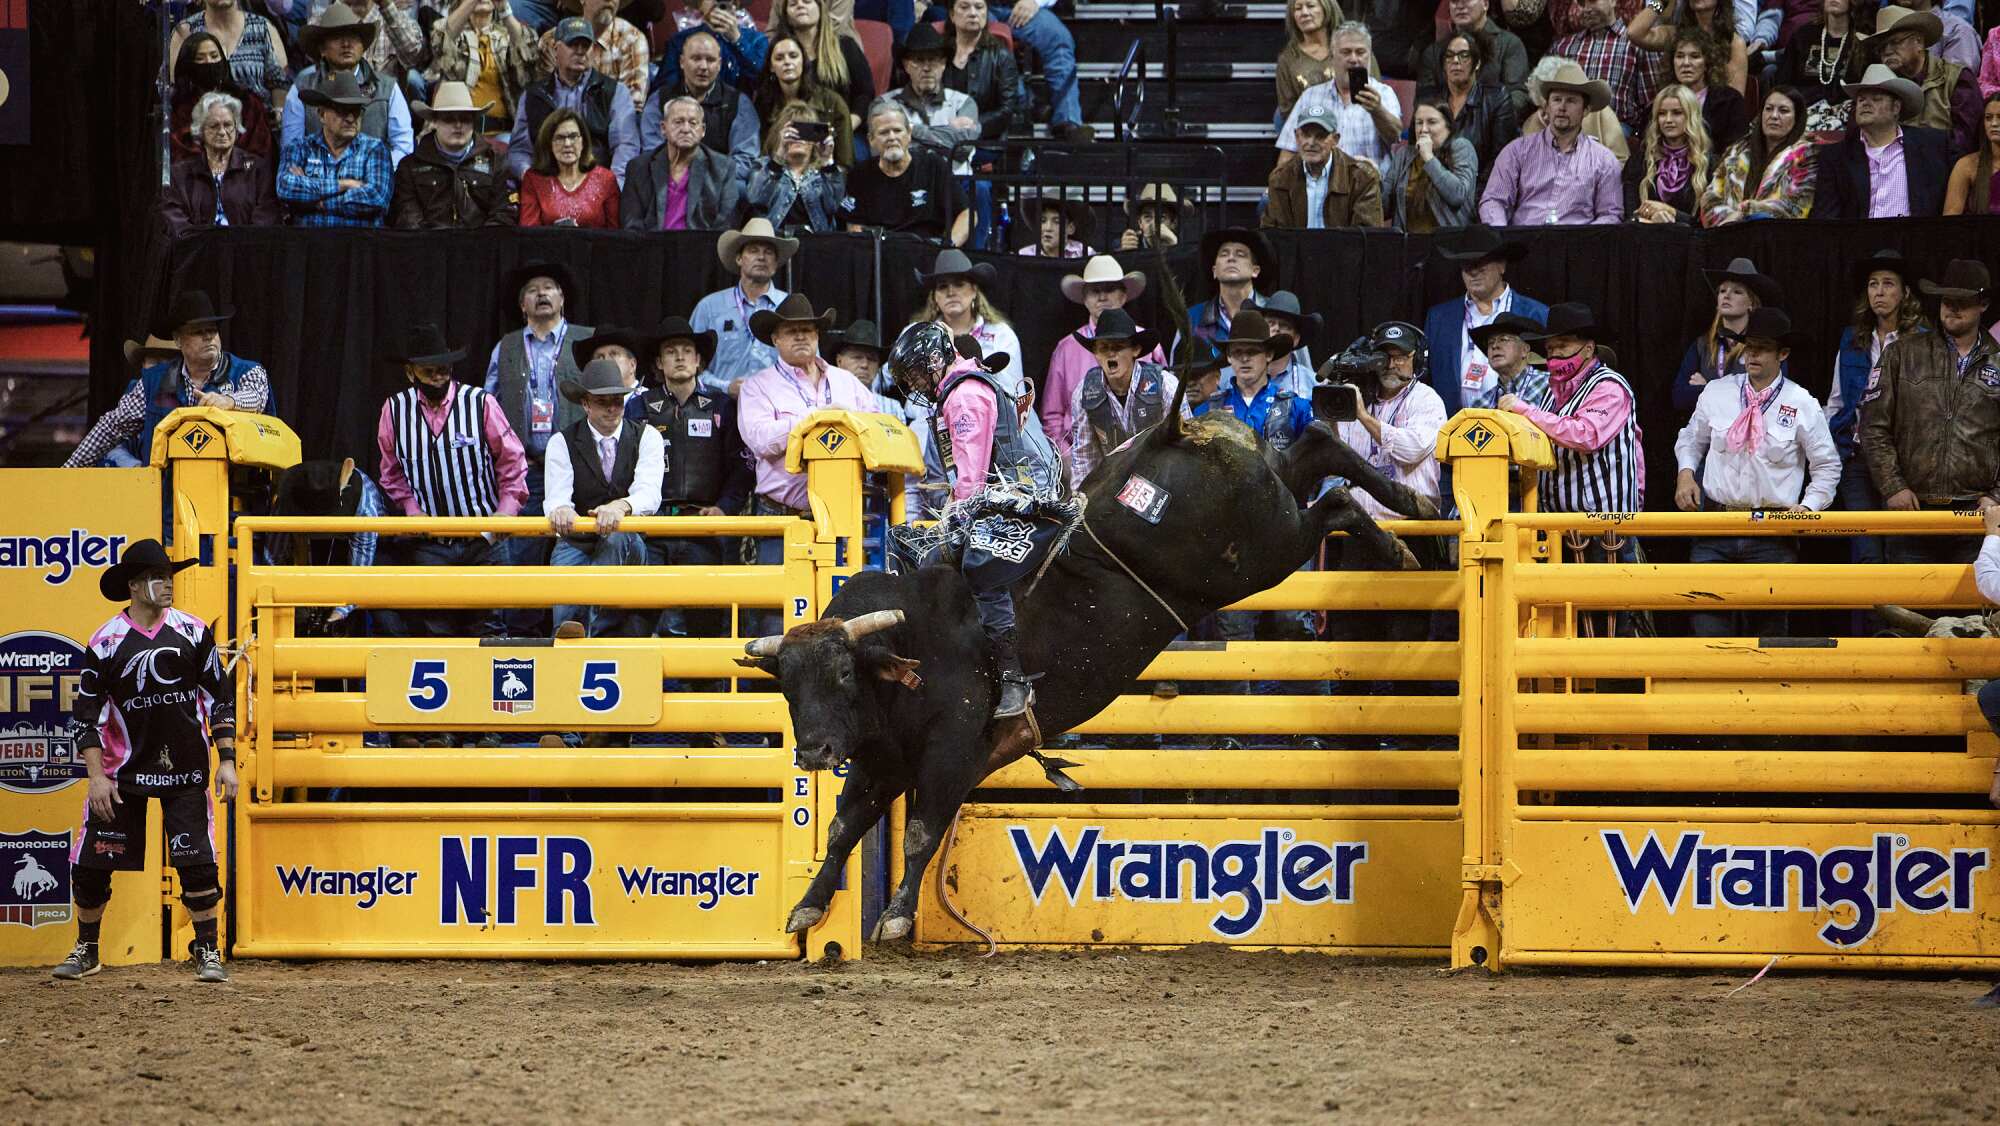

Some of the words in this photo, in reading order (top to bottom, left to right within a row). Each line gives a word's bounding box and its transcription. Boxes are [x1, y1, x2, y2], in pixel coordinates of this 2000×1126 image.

[1585, 511, 1637, 525] Wrangler
[0, 651, 73, 674] Wrangler
[131, 689, 197, 710] CHOCTAW
[408, 660, 449, 711] 5
[580, 661, 621, 712] 5
[42, 768, 73, 776] RIDGE
[135, 772, 189, 787] ROUGHY
[0, 841, 68, 849] PRORODEO
[276, 865, 418, 910] Wrangler
[440, 836, 596, 926] NFR
[617, 865, 760, 911] Wrangler
[1009, 827, 1367, 936] Wrangler
[1602, 831, 1988, 948] Wrangler
[37, 910, 67, 918] PRCA
